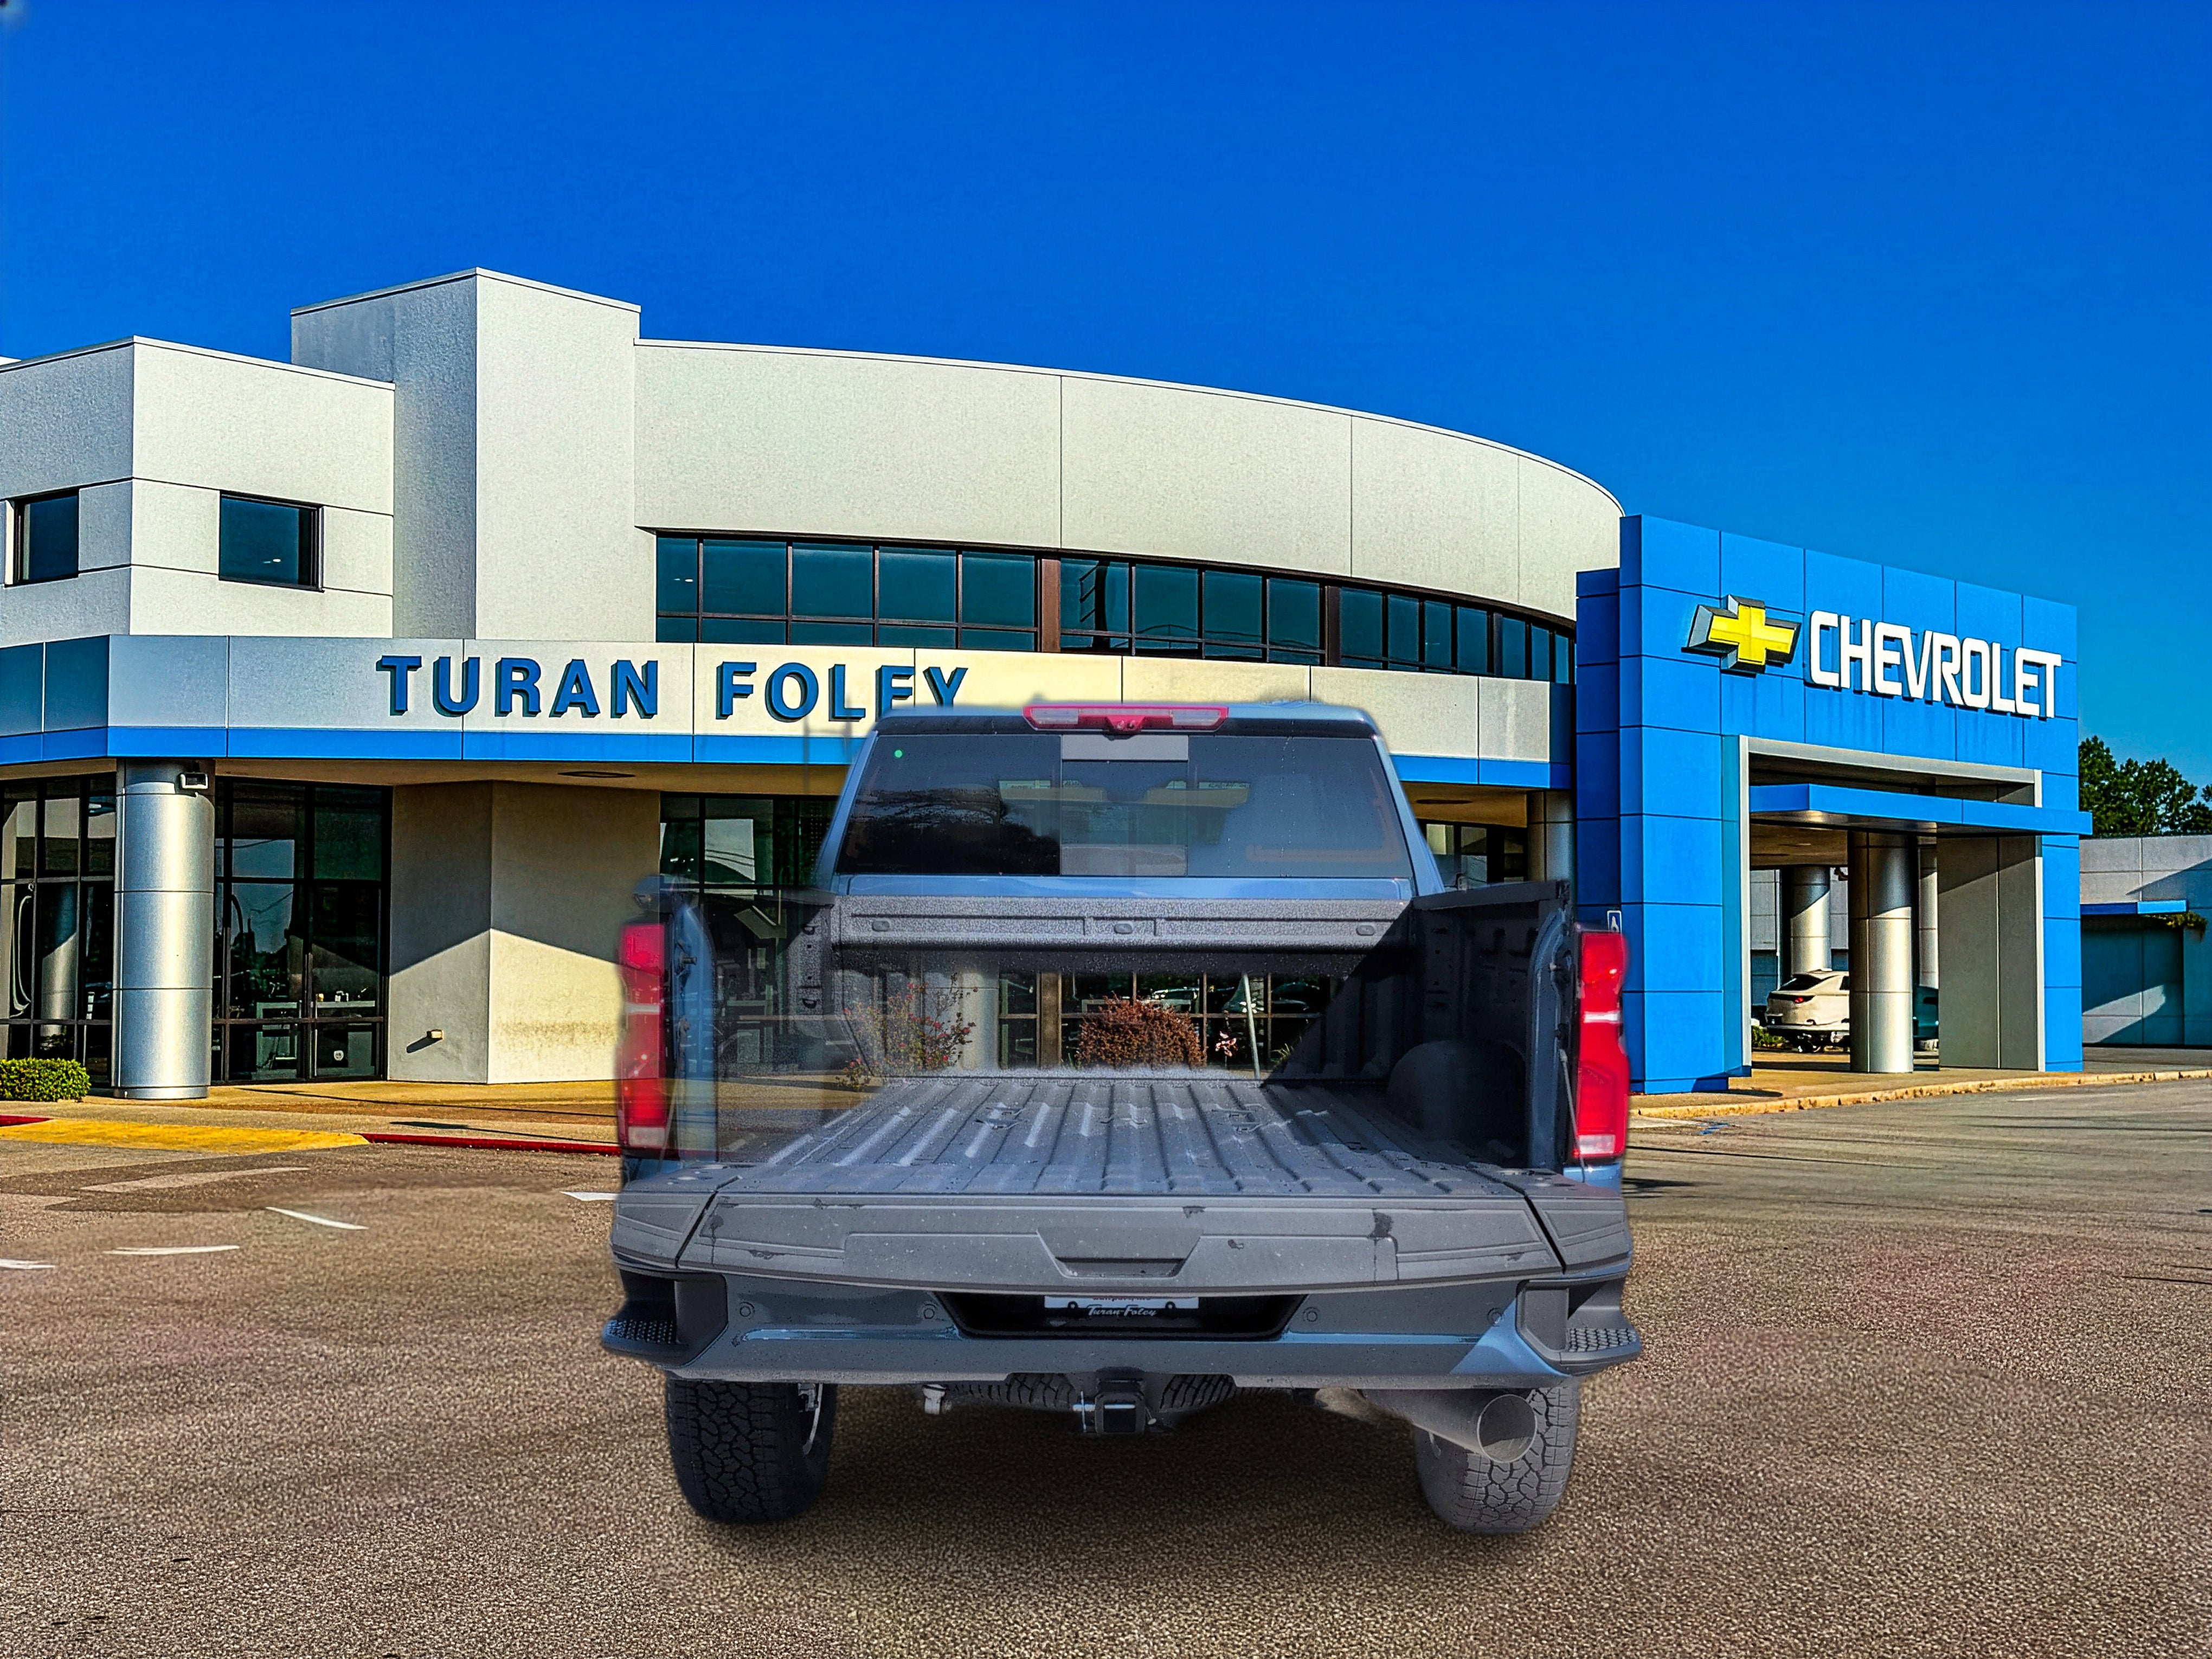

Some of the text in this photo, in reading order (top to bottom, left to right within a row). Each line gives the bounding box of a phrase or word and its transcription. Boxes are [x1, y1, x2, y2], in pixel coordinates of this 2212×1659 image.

[376, 655, 968, 722] TURAN FOLEY
[1809, 610, 2062, 718] CHEVROLET
